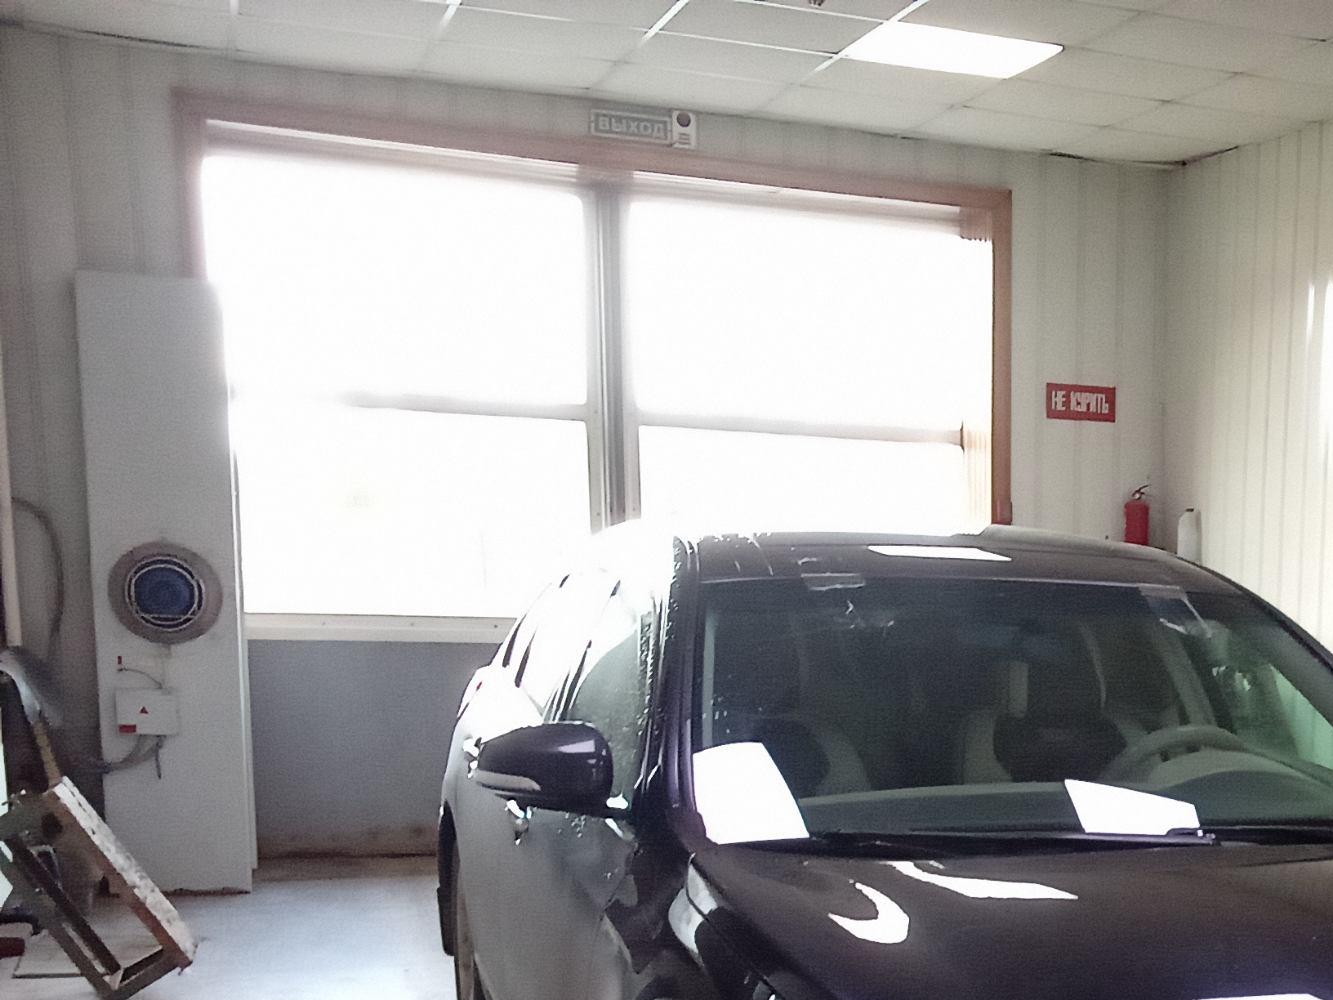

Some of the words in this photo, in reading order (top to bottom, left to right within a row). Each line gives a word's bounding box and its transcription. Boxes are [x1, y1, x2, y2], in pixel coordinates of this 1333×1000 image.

[599, 115, 665, 139] ВЫХОД
[1051, 390, 1067, 411] НЕ
[1070, 391, 1109, 414] КУРИТЬ
